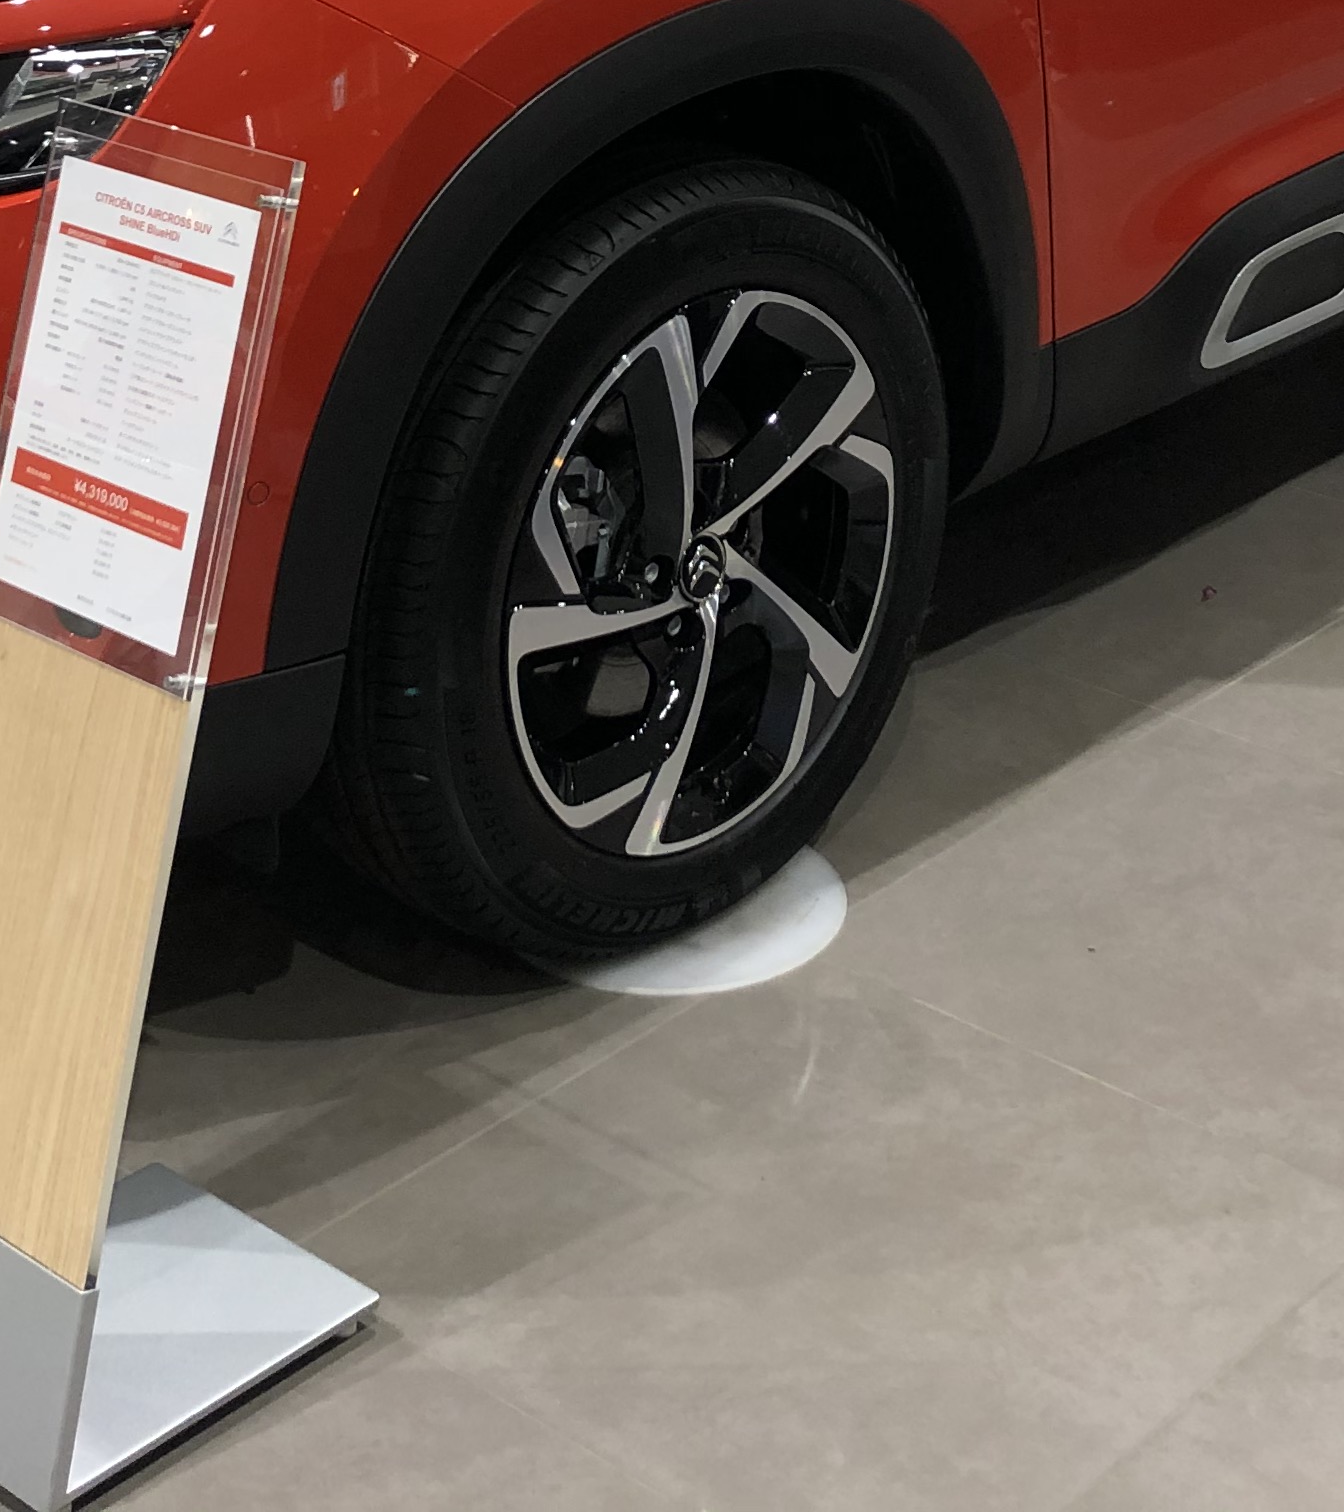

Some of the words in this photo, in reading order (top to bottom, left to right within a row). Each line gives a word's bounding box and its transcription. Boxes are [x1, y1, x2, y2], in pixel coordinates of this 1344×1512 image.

[119, 215, 145, 231] SHINE
[134, 203, 146, 216] C5
[146, 207, 192, 230] AIRCROSS
[194, 220, 213, 235] SUV
